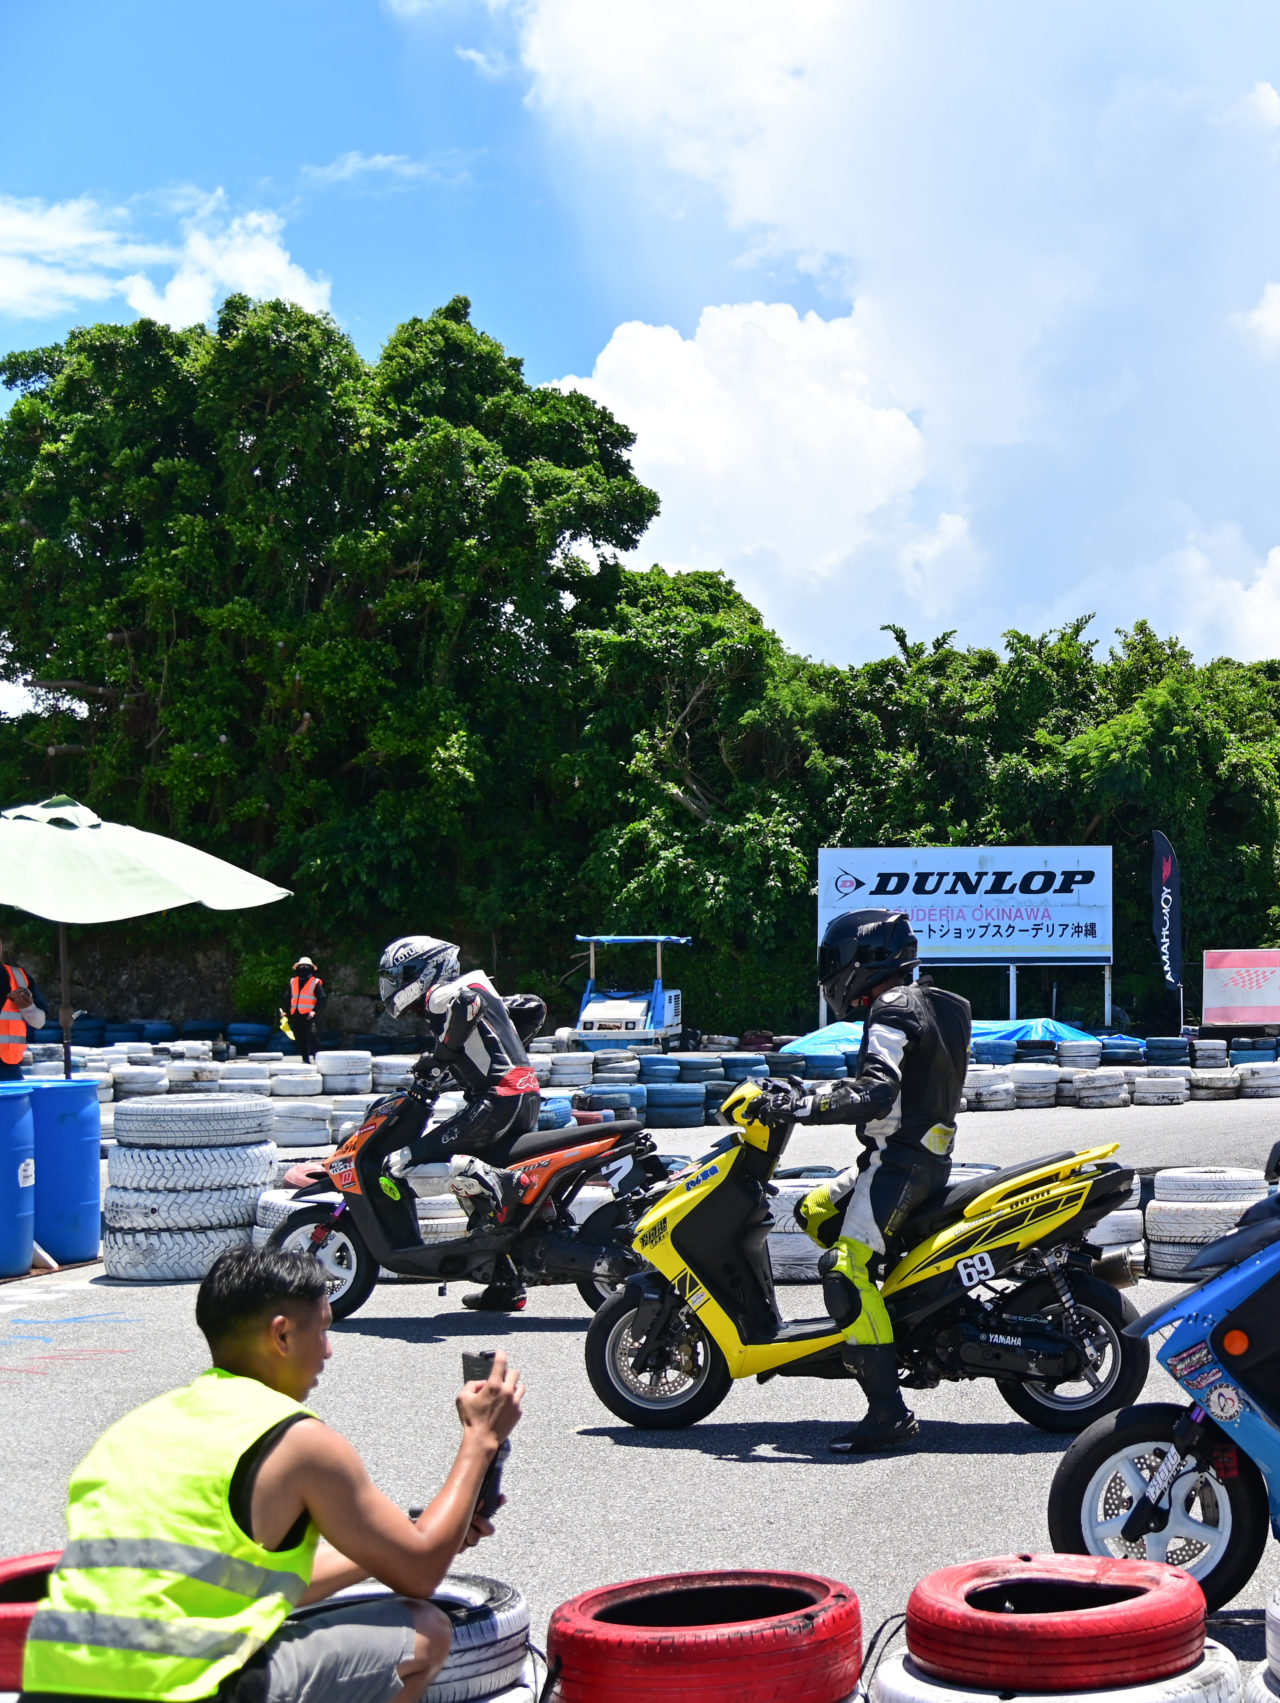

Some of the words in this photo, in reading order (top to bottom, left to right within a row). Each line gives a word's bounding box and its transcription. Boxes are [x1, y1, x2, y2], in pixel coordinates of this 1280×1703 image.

[868, 870, 1096, 896] DUNLOP
[892, 908, 967, 922] UDERIA
[971, 908, 1053, 922] OKINAWA
[912, 922, 1098, 939] ートショップスクーデリア沖縄
[956, 1251, 996, 1287] 69
[988, 1333, 1022, 1347] YAMAHA
